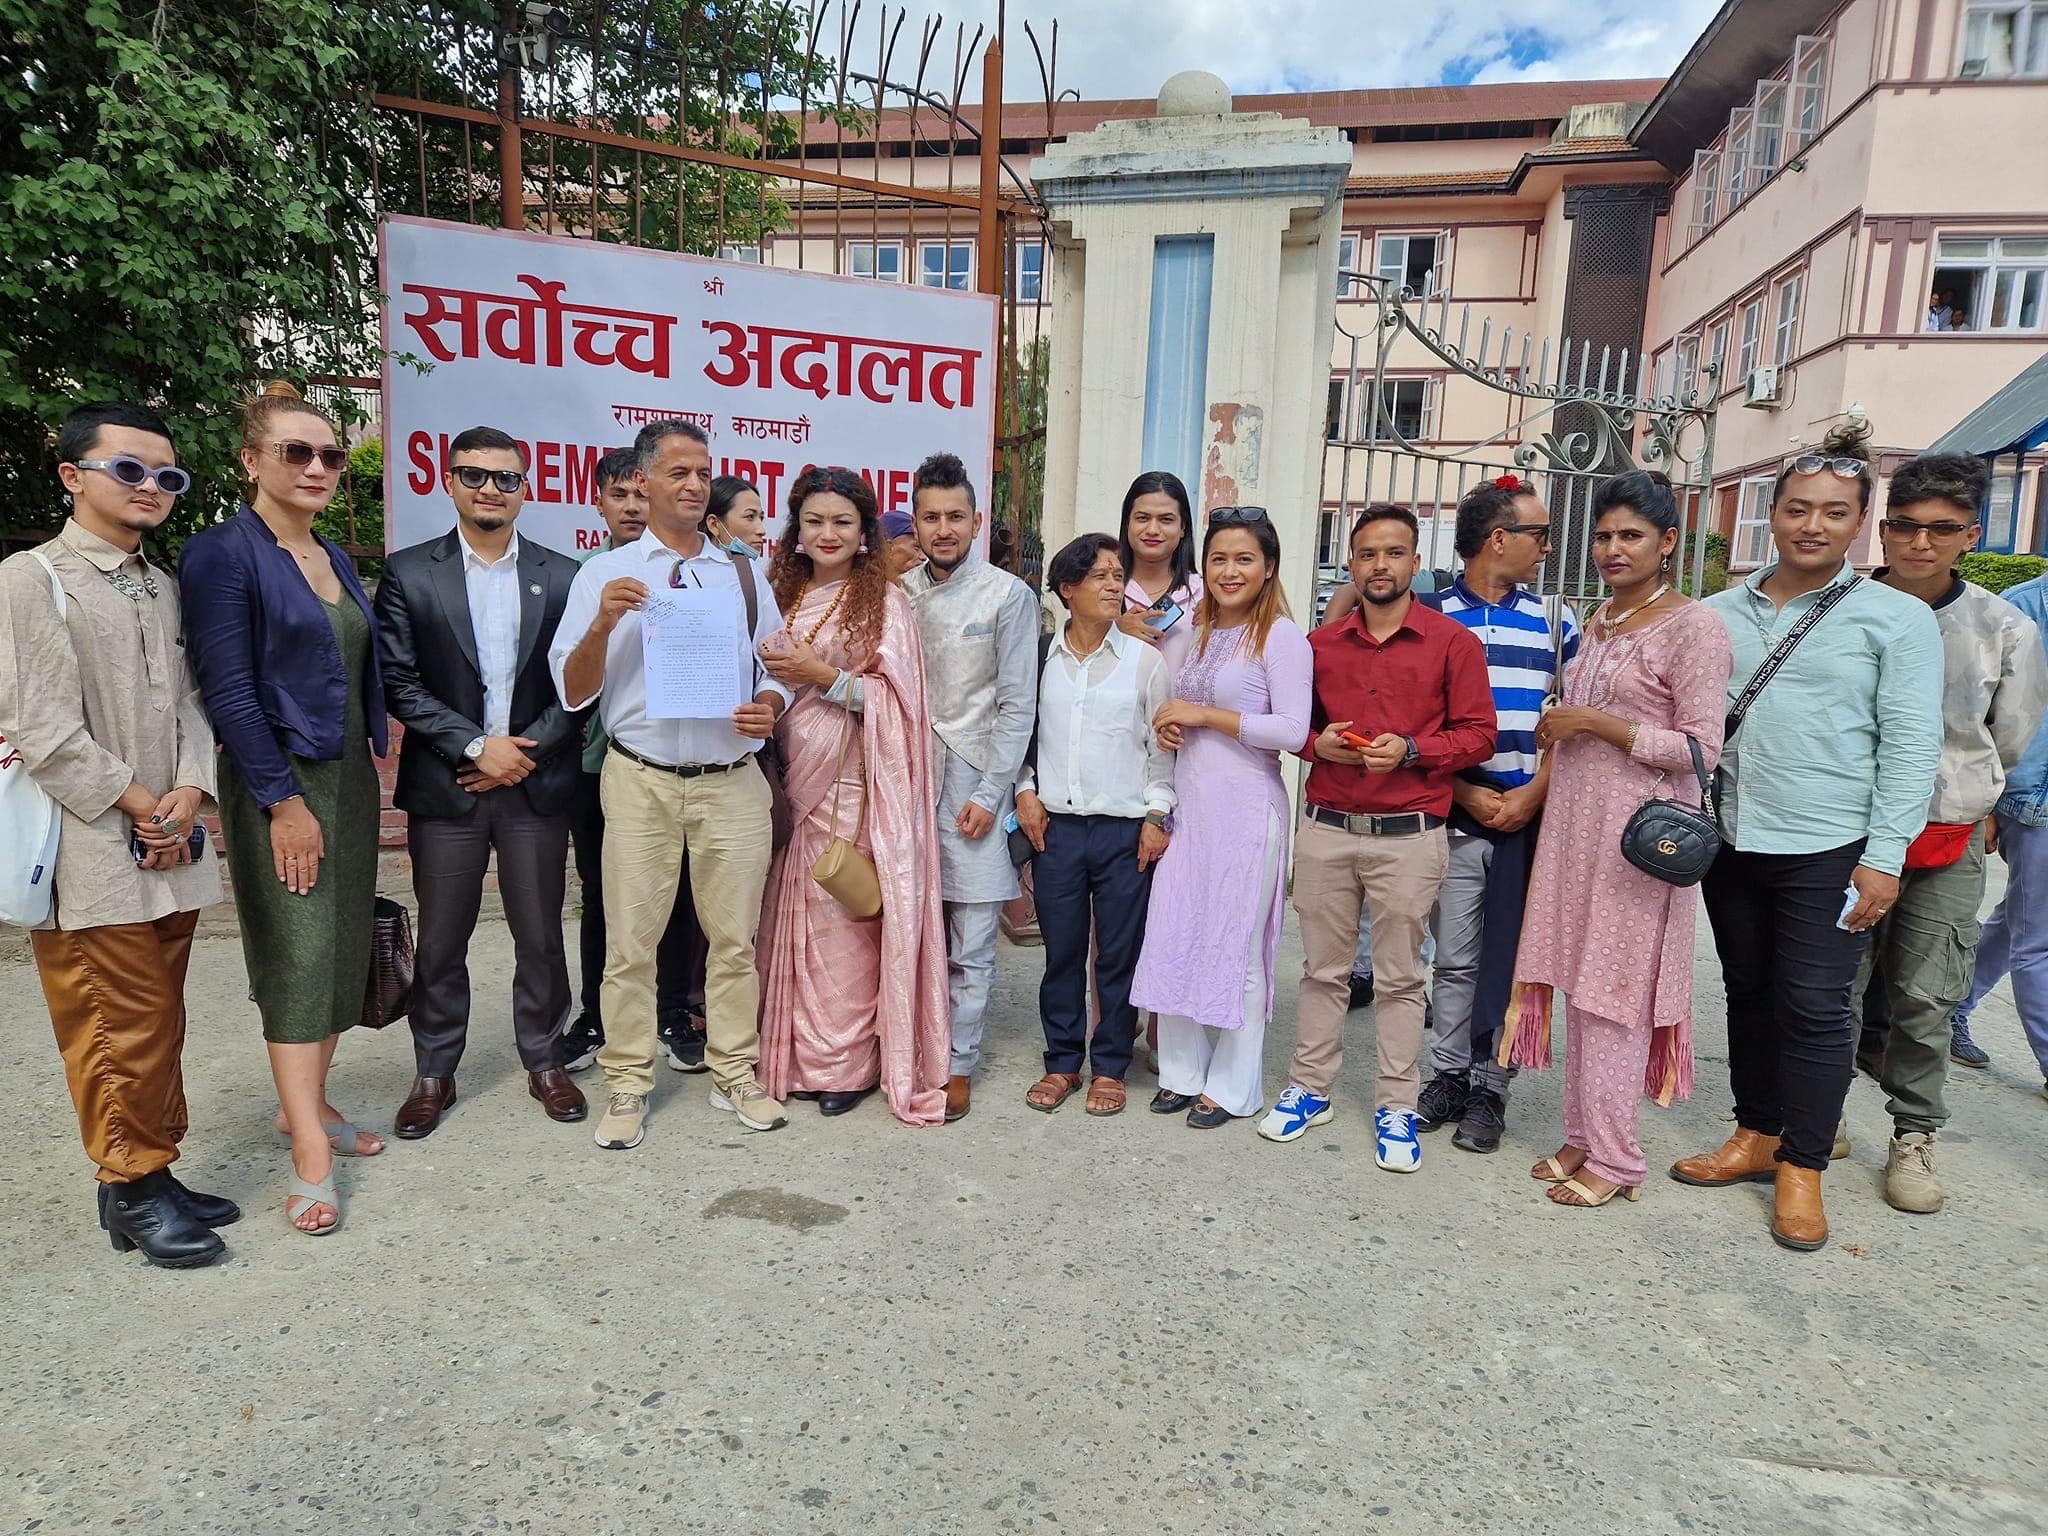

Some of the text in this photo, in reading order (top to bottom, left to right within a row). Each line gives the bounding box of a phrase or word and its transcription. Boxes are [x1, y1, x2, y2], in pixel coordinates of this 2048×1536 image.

[703, 276, 725, 297] श्री
[402, 274, 982, 410] सर्वोच्च अदालत
[1776, 637, 1796, 658] KORS
[1749, 659, 1778, 691] MICHAEL
[1734, 693, 1752, 716] KORS
